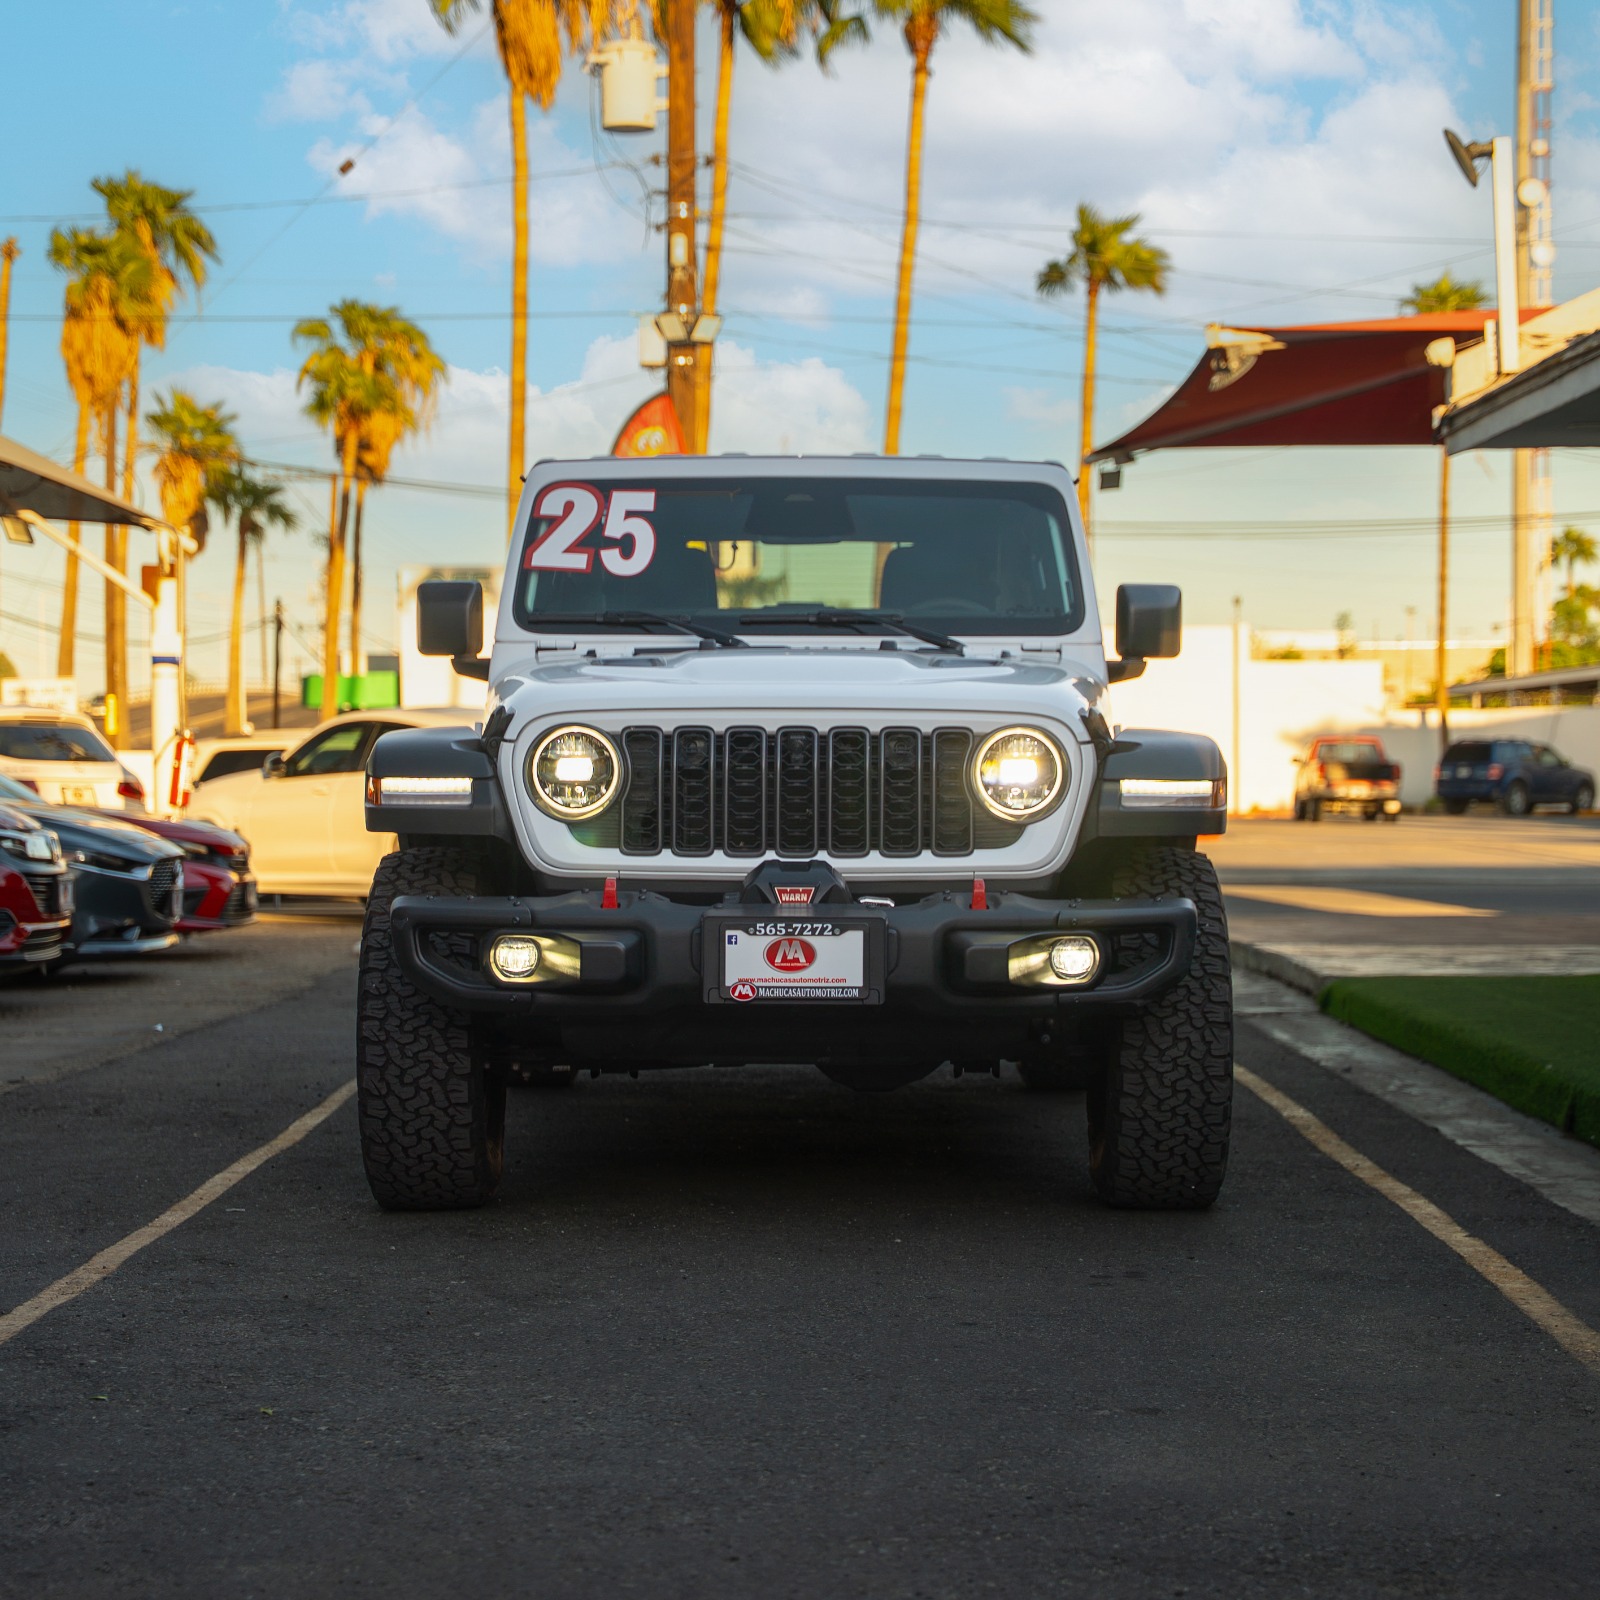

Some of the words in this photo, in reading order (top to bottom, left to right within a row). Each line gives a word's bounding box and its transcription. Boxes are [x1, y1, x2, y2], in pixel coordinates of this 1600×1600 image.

[523, 480, 657, 577] 25
[781, 893, 808, 902] WARN
[756, 923, 833, 935] 565-7272
[758, 987, 859, 998] MACHUCASAUTOMOTRIZ.COM
